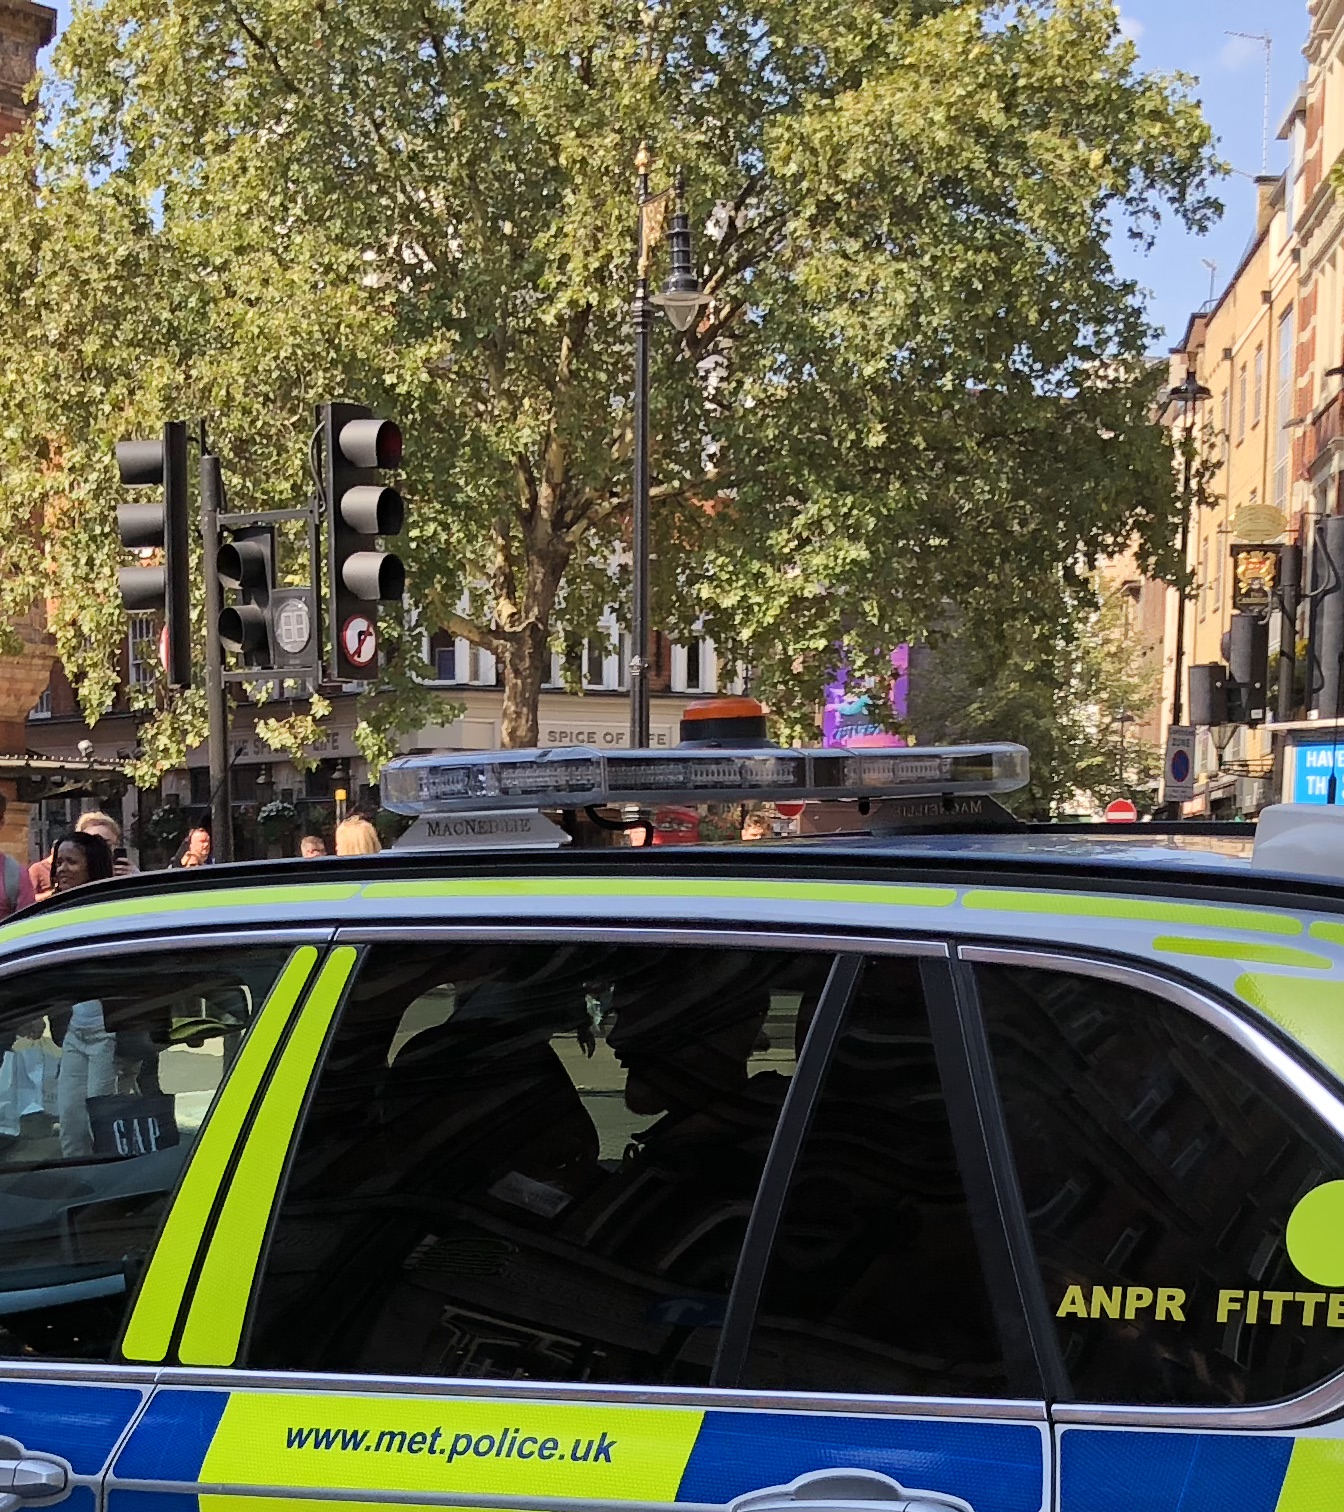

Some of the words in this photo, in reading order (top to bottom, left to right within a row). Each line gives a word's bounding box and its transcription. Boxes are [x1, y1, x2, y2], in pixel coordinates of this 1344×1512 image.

[547, 729, 598, 744] SPICE
[603, 732, 626, 744] OF
[1306, 775, 1330, 796] TH
[112, 1116, 161, 1157] GAP
[1056, 1284, 1186, 1322] ANPR
[285, 1425, 618, 1464] www.met.police.uk
